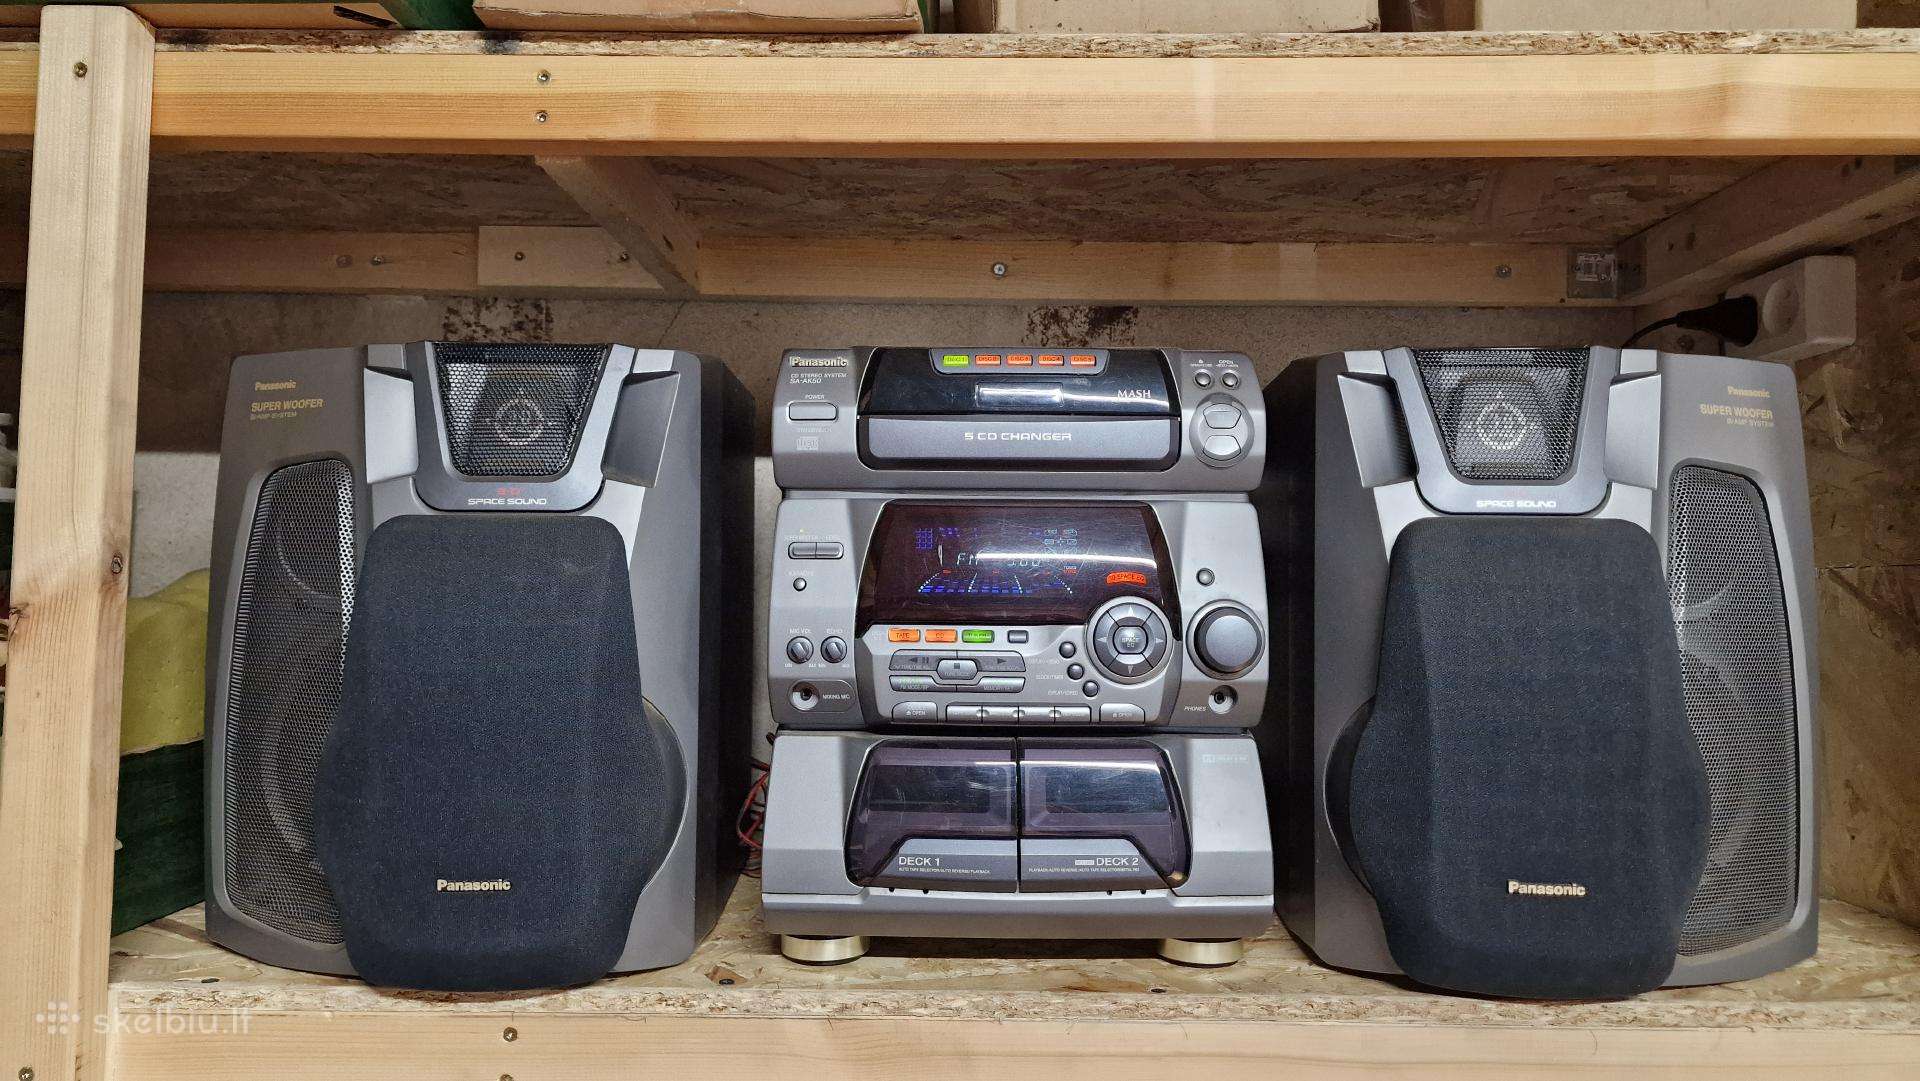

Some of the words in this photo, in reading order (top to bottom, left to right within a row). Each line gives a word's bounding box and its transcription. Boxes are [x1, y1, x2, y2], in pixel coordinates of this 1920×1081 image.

[790, 356, 848, 367] Panasonic
[254, 380, 297, 391] Panasonic
[1117, 389, 1152, 399] MASH
[251, 400, 281, 413] SUPER
[283, 398, 325, 410] WOOFER
[1699, 403, 1732, 416] SUPER
[1733, 407, 1774, 421] WOOFER
[964, 431, 974, 441] 5
[977, 431, 998, 441] CD
[1000, 431, 1073, 441] CHANGER
[1476, 500, 1515, 508] SPACE
[1516, 500, 1557, 508] SOUND
[898, 856, 933, 867] DECK
[934, 857, 940, 867] 1
[1096, 857, 1130, 866] DECK
[1132, 857, 1139, 866] 2
[436, 879, 512, 891] Panasonic
[1508, 880, 1586, 896] Panasonic
